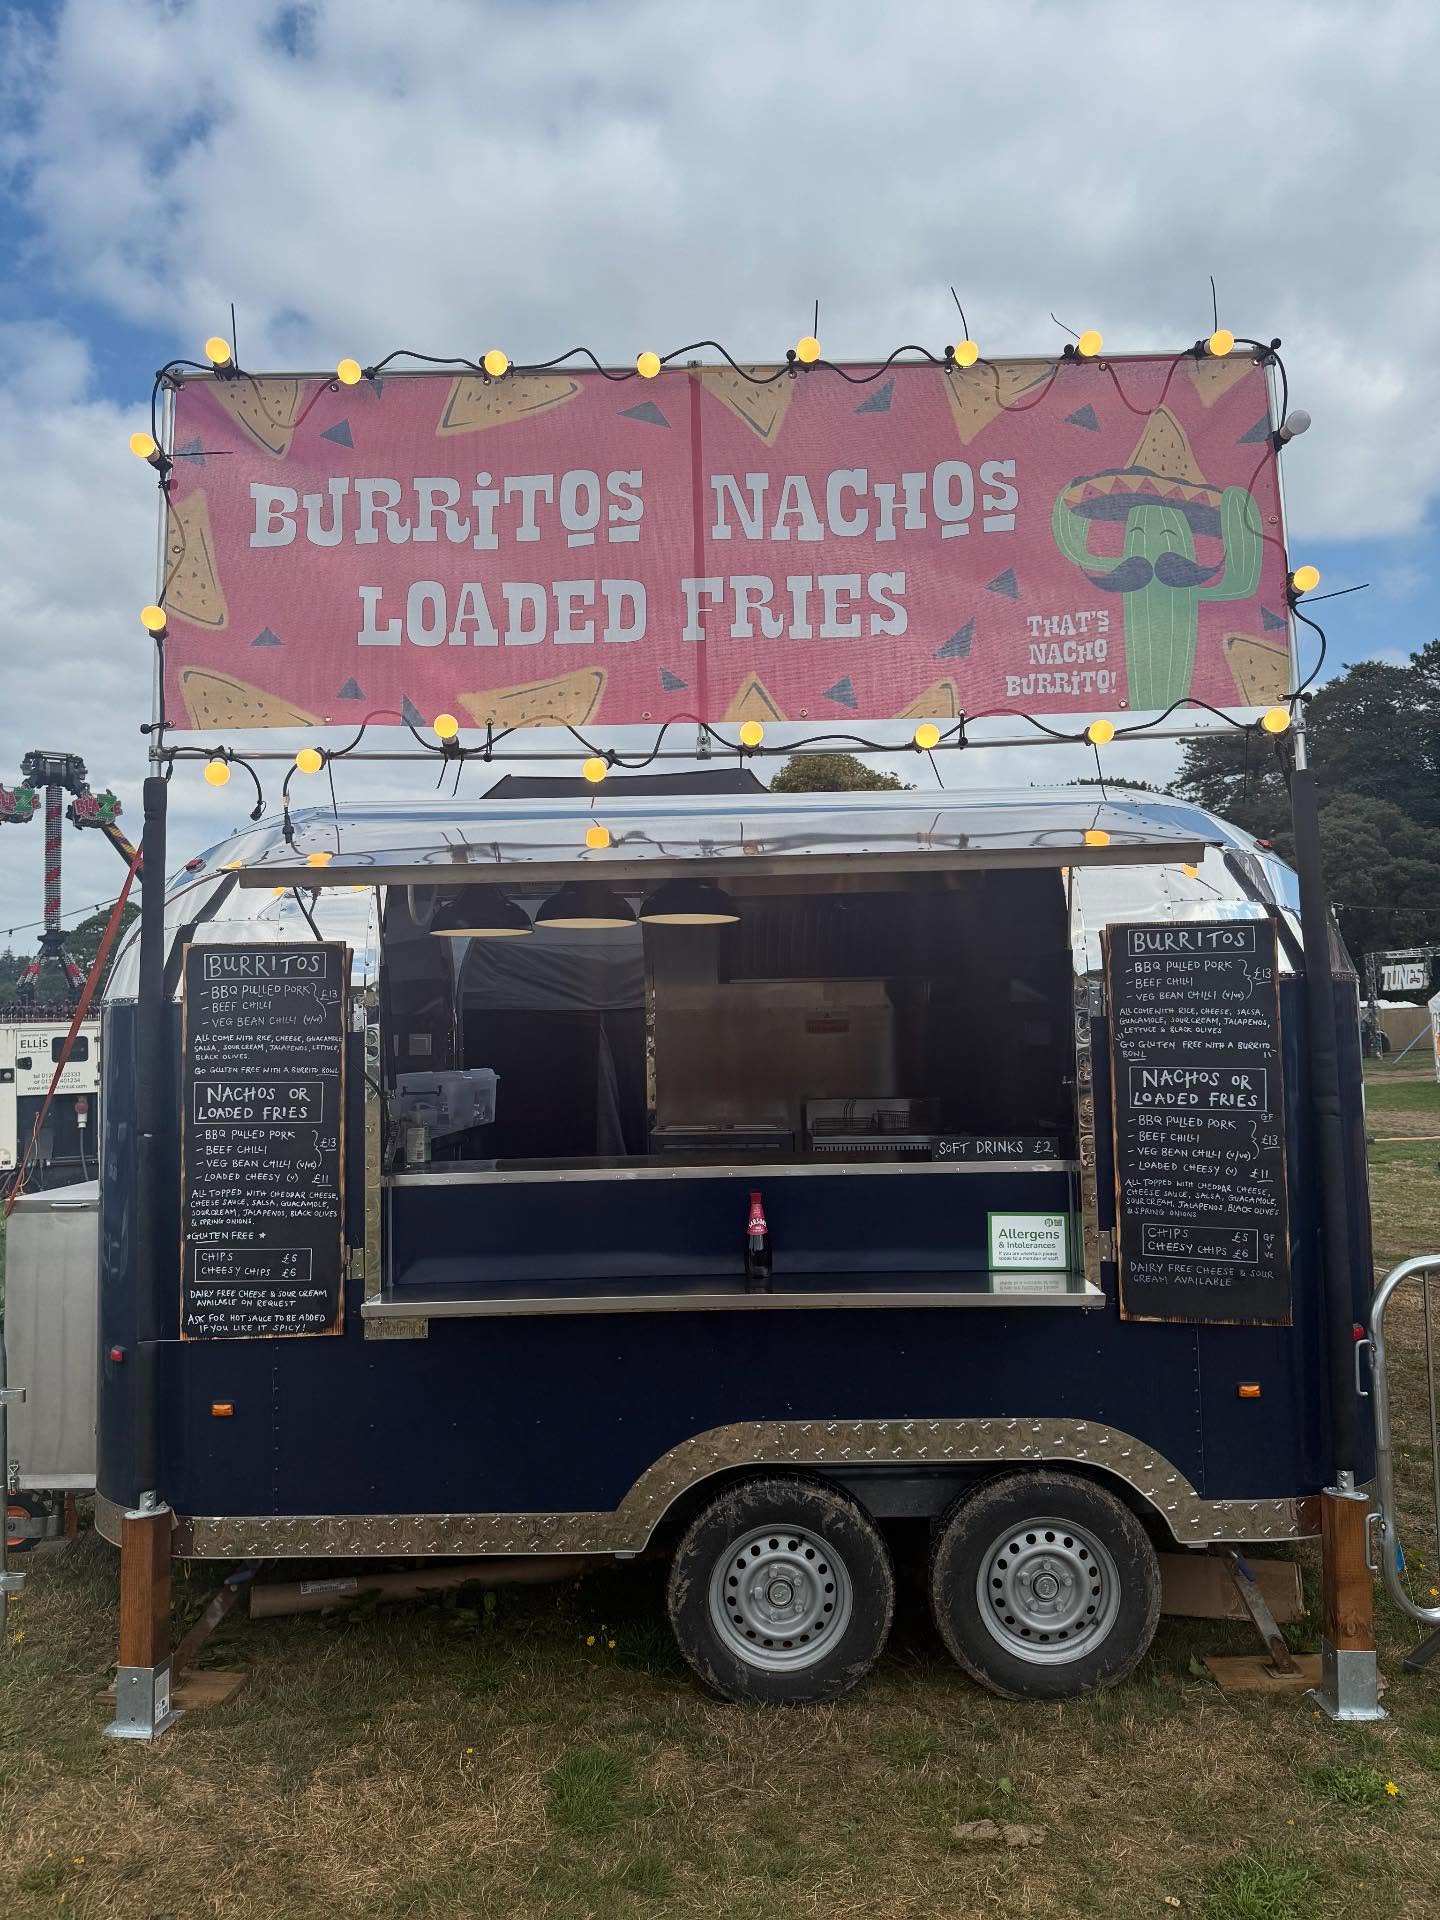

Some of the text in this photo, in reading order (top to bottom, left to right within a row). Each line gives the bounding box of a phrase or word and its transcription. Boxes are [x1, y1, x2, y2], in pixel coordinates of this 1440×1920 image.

[711, 459, 1019, 542] NACHOS
[357, 571, 909, 648] LOADED FRIES
[1027, 610, 1109, 637] THAT'S
[1029, 639, 1108, 664] NACHO
[1134, 931, 1245, 952] BURRITOS
[209, 955, 320, 977] BURRITOS
[1135, 960, 1233, 973] BBQ PULLED PORK
[1253, 968, 1272, 980] £13
[1136, 977, 1193, 989] BEEF CHILLI
[211, 985, 310, 999] BBQ PULLED PORK
[321, 990, 338, 1001] £13
[1136, 993, 1155, 1001] VEG
[1188, 991, 1216, 999] CHILLI
[212, 1001, 271, 1013] BEEF CHILLI
[1120, 1008, 1132, 1016] ALL
[211, 1016, 296, 1028] VEG BEAN CHILLI
[195, 1035, 209, 1043] ALL
[276, 1035, 304, 1043] CHEESE,
[1143, 1070, 1252, 1090] NACHOS OR
[207, 1085, 311, 1103] NACHOS OR
[1134, 1092, 1258, 1107] LOADED FRIES
[198, 1107, 308, 1120] LOADED FRIES
[1138, 1115, 1236, 1129] BBQ PULLED PORK
[205, 1129, 296, 1140] BBQ PULLED PORK
[1139, 1131, 1199, 1143] BEEF CHILLI
[1261, 1135, 1278, 1145] £13
[320, 1138, 336, 1148] £13
[939, 1141, 1053, 1154] SOFT DRINKS £2
[206, 1145, 267, 1155] BEEF CHILLI
[1137, 1147, 1220, 1159] VEG BEAN CHILLI
[206, 1159, 228, 1167] VEG
[263, 1160, 290, 1168] CHILLI
[1139, 1162, 1219, 1176] LOADED CHEESY
[205, 1173, 240, 1181] LOADED
[1125, 1179, 1141, 1187] ALL
[1198, 1182, 1231, 1191] CHEDDAR
[192, 1190, 207, 1198] ALL
[209, 1189, 242, 1197] TOPPED
[1195, 1192, 1224, 1201] SALSA,
[1170, 1210, 1196, 1218] ONIONS
[999, 1229, 1059, 1241] Allergens
[1148, 1228, 1248, 1243] CHIPS £5
[201, 1252, 233, 1261] CHIPS
[1148, 1242, 1248, 1260] CHEESY CHIPS £6
[201, 1267, 270, 1276] CHEESY CHIPS
[1130, 1262, 1274, 1279] DAIRY FREE CHEESE SOUR
[1133, 1275, 1232, 1286] CREAM AVAILABLE
[190, 1290, 213, 1299] DAIRY
[217, 1289, 235, 1297] FREE
[197, 1299, 237, 1307] AVAILABLE
[188, 1314, 205, 1325] ASK
[209, 1314, 224, 1322] FOR
[200, 1325, 209, 1333] IF
[273, 1324, 305, 1332] SPICY!
